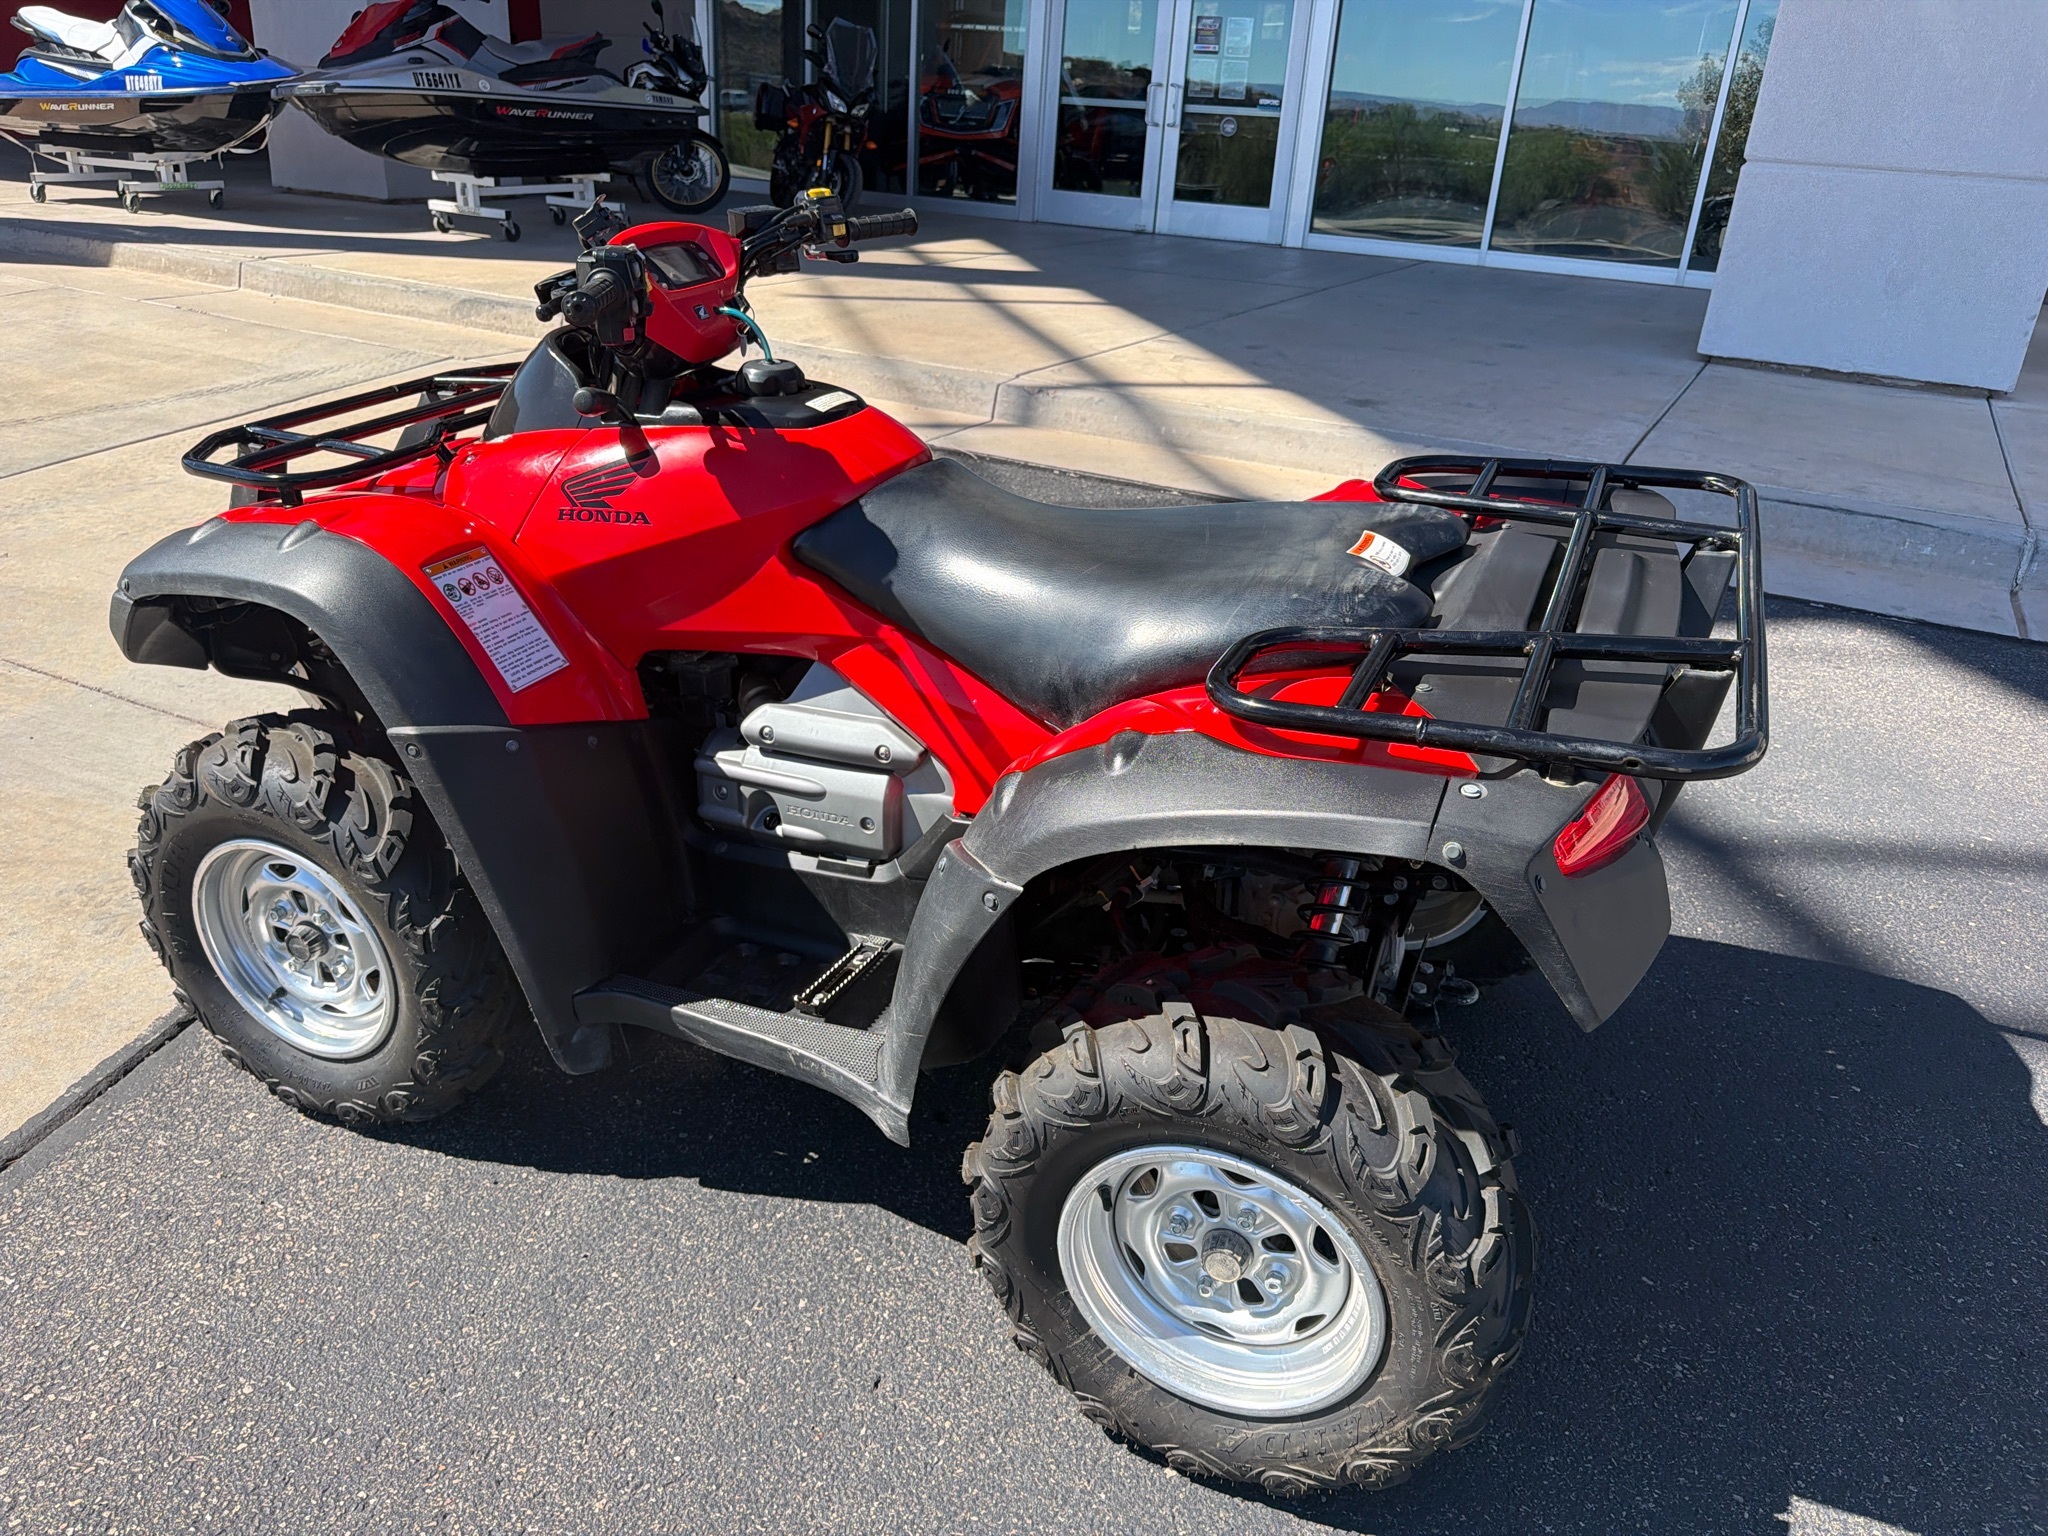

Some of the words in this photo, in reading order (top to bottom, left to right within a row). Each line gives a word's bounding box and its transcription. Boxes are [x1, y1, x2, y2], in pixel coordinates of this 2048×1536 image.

[412, 71, 462, 89] UT6641YX
[557, 508, 652, 526] HONDA
[786, 805, 854, 827] HONDA
